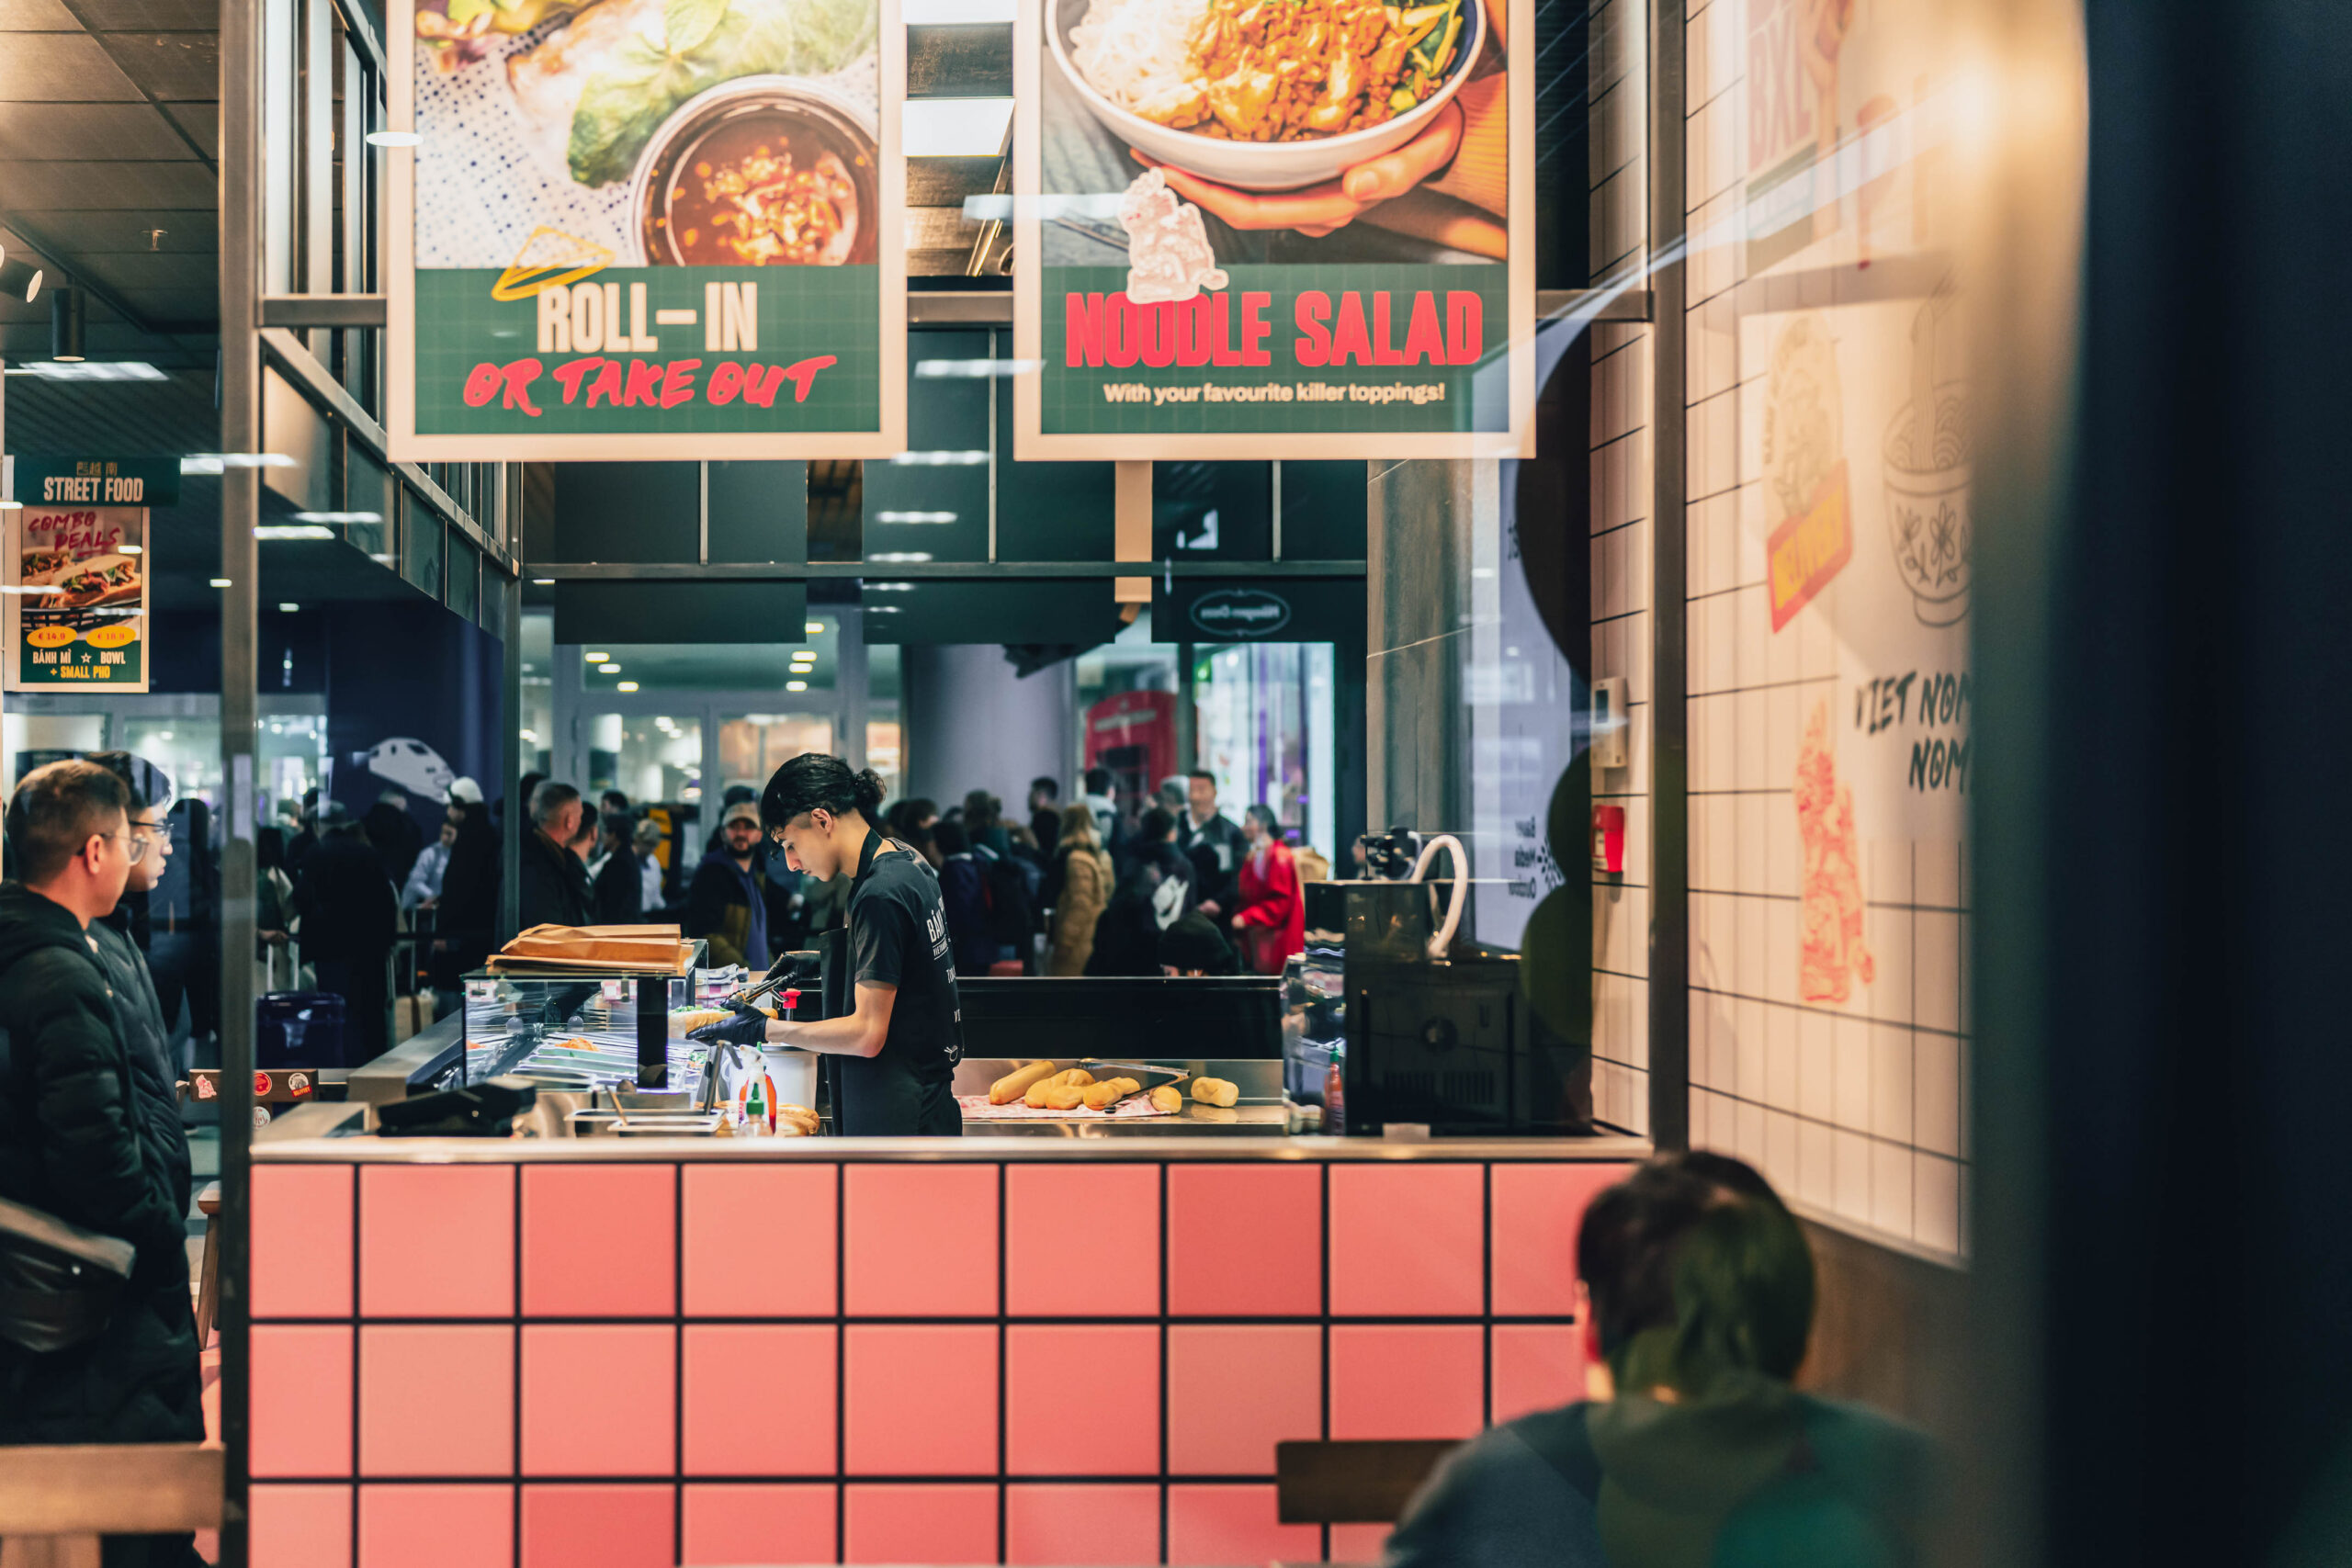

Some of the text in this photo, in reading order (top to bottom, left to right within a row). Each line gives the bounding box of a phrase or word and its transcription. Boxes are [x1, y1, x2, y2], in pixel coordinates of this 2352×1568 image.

[1066, 290, 1483, 368] NOODLE SALAD
[463, 355, 838, 417] OR TAKE OUT
[1103, 382, 1446, 406] With your favourite killer toppings!
[44, 476, 143, 502] STREET FOOD
[28, 512, 96, 533] COMBO
[54, 527, 120, 552] DEALS
[32, 649, 57, 664] BÁNH
[100, 651, 126, 664] BOWL
[61, 665, 89, 679] SMALL
[93, 665, 110, 679] PHO
[1909, 737, 1970, 795] NOM
